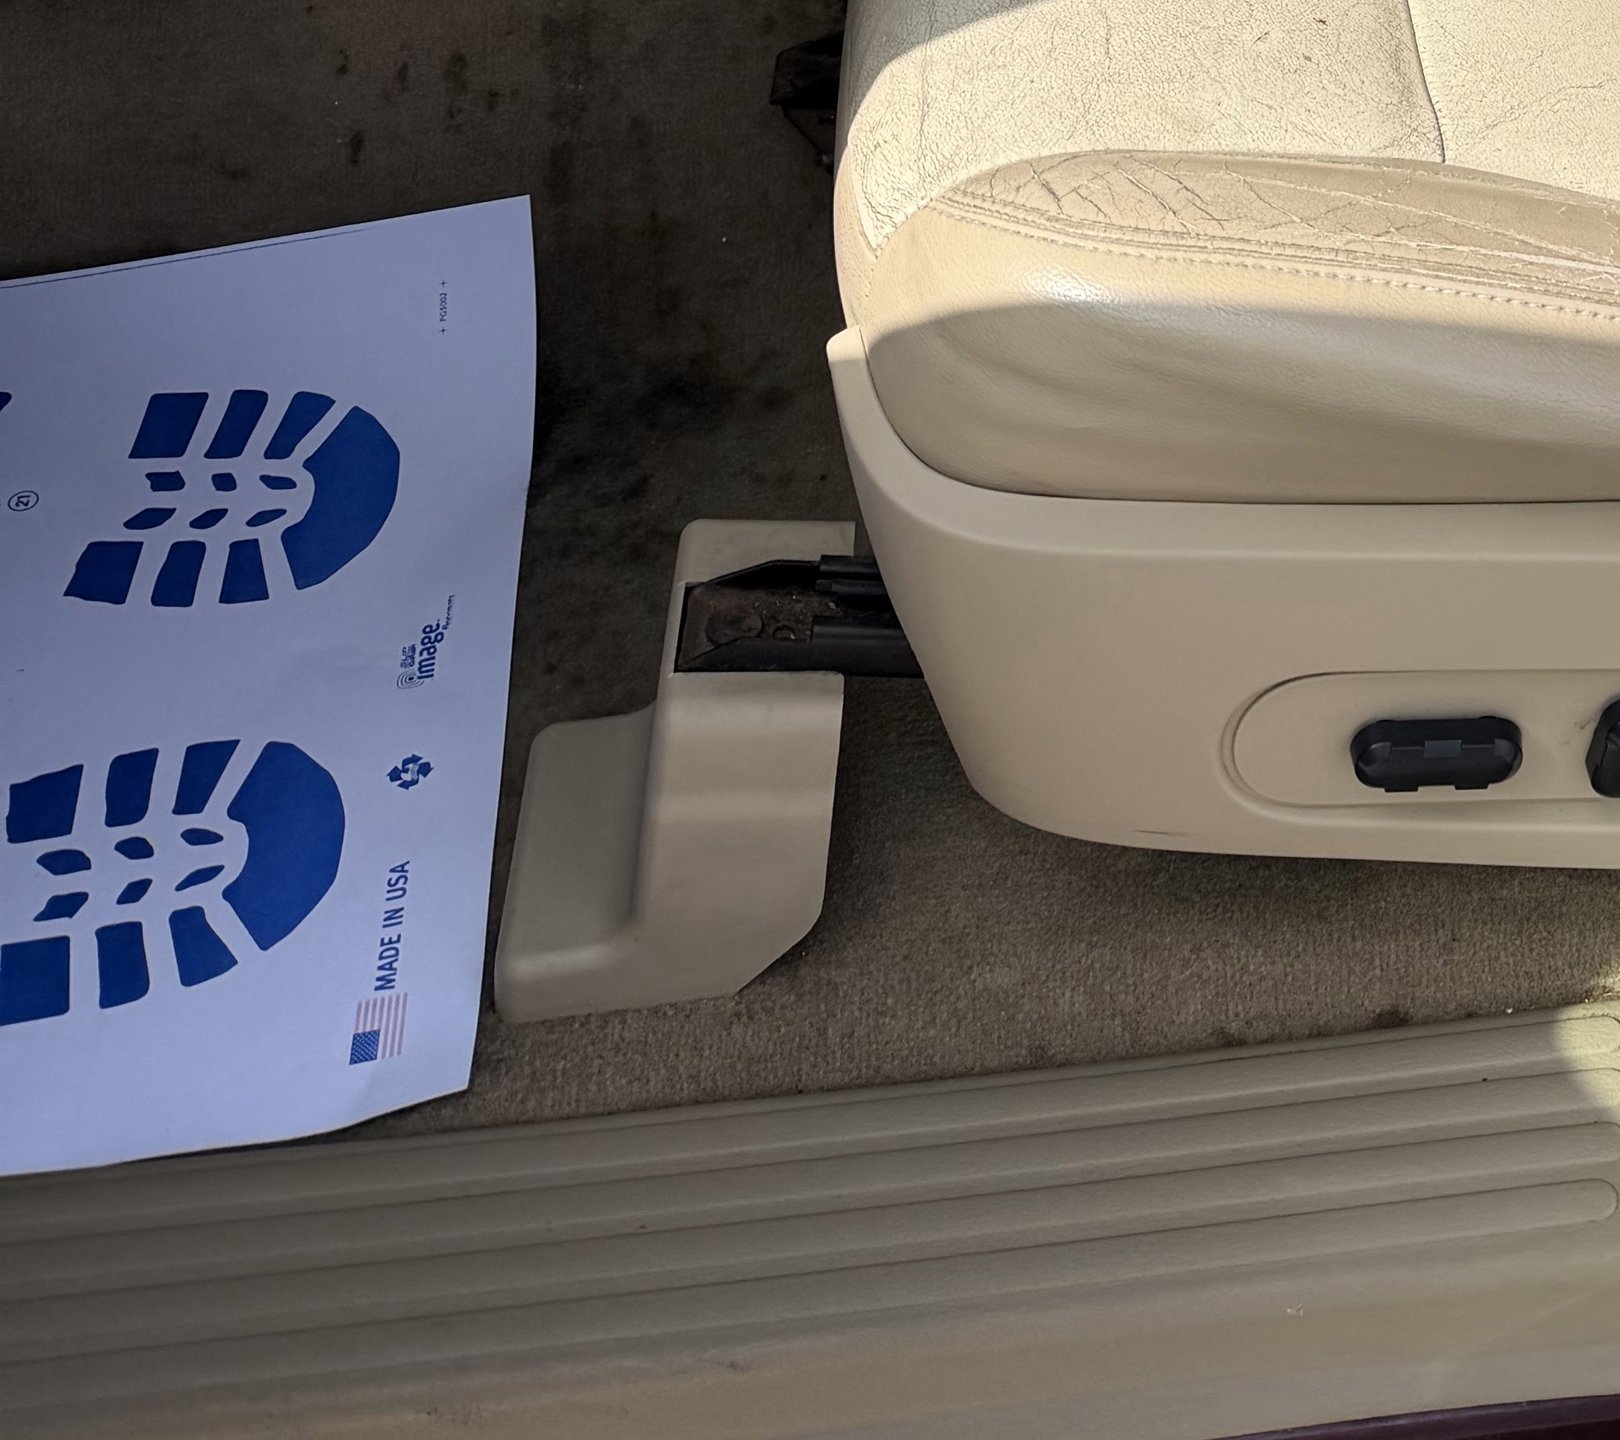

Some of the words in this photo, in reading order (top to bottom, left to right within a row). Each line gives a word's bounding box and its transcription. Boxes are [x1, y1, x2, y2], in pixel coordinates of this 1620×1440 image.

[385, 860, 410, 901] USA
[382, 906, 404, 928] IN
[374, 933, 402, 991] MADE
